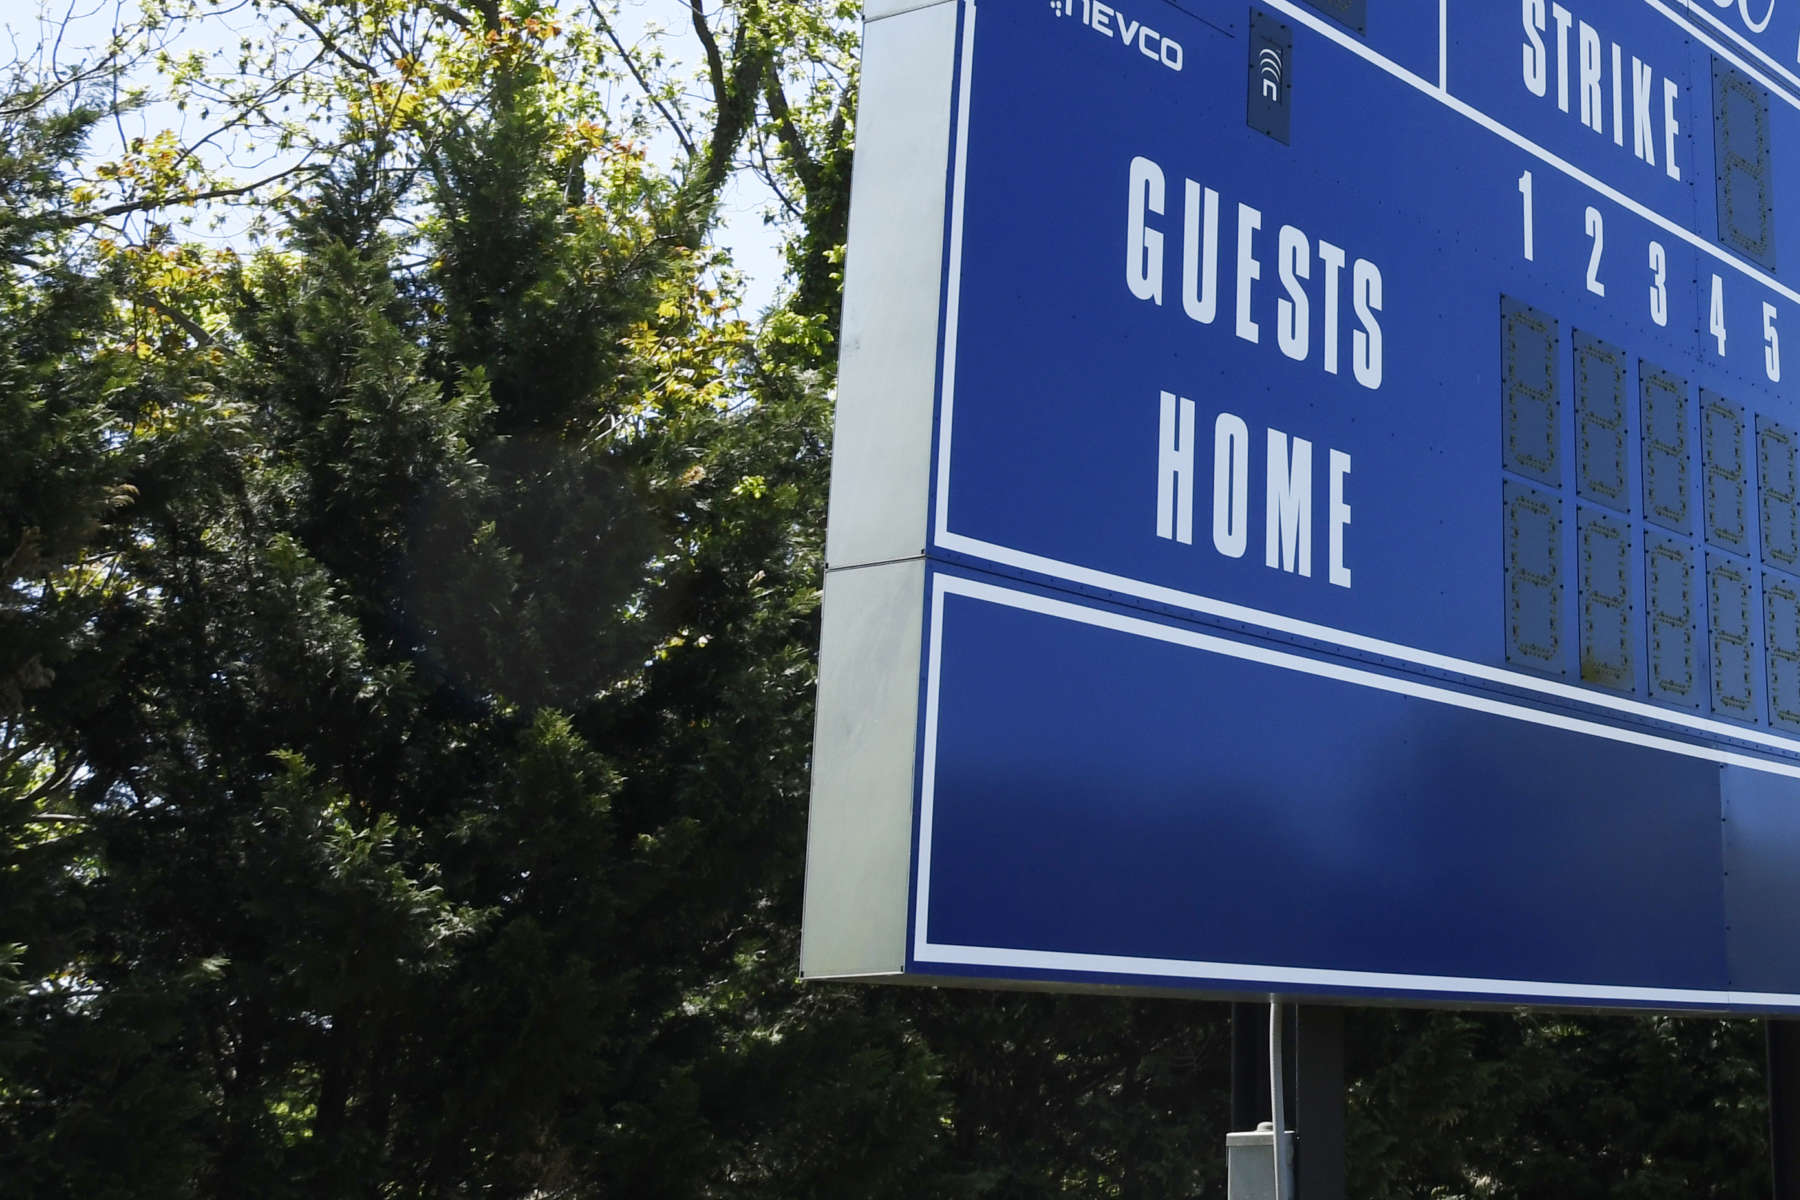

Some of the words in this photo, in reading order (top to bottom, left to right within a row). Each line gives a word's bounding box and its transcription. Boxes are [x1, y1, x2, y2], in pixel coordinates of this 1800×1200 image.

[1126, 156, 1383, 390] GUESTS
[1518, 170, 1534, 261] 1
[1585, 206, 1605, 297] 2
[1648, 240, 1668, 327] 3
[1709, 273, 1727, 357] 4
[1762, 301, 1781, 383] 5
[1156, 390, 1351, 589] HOME
